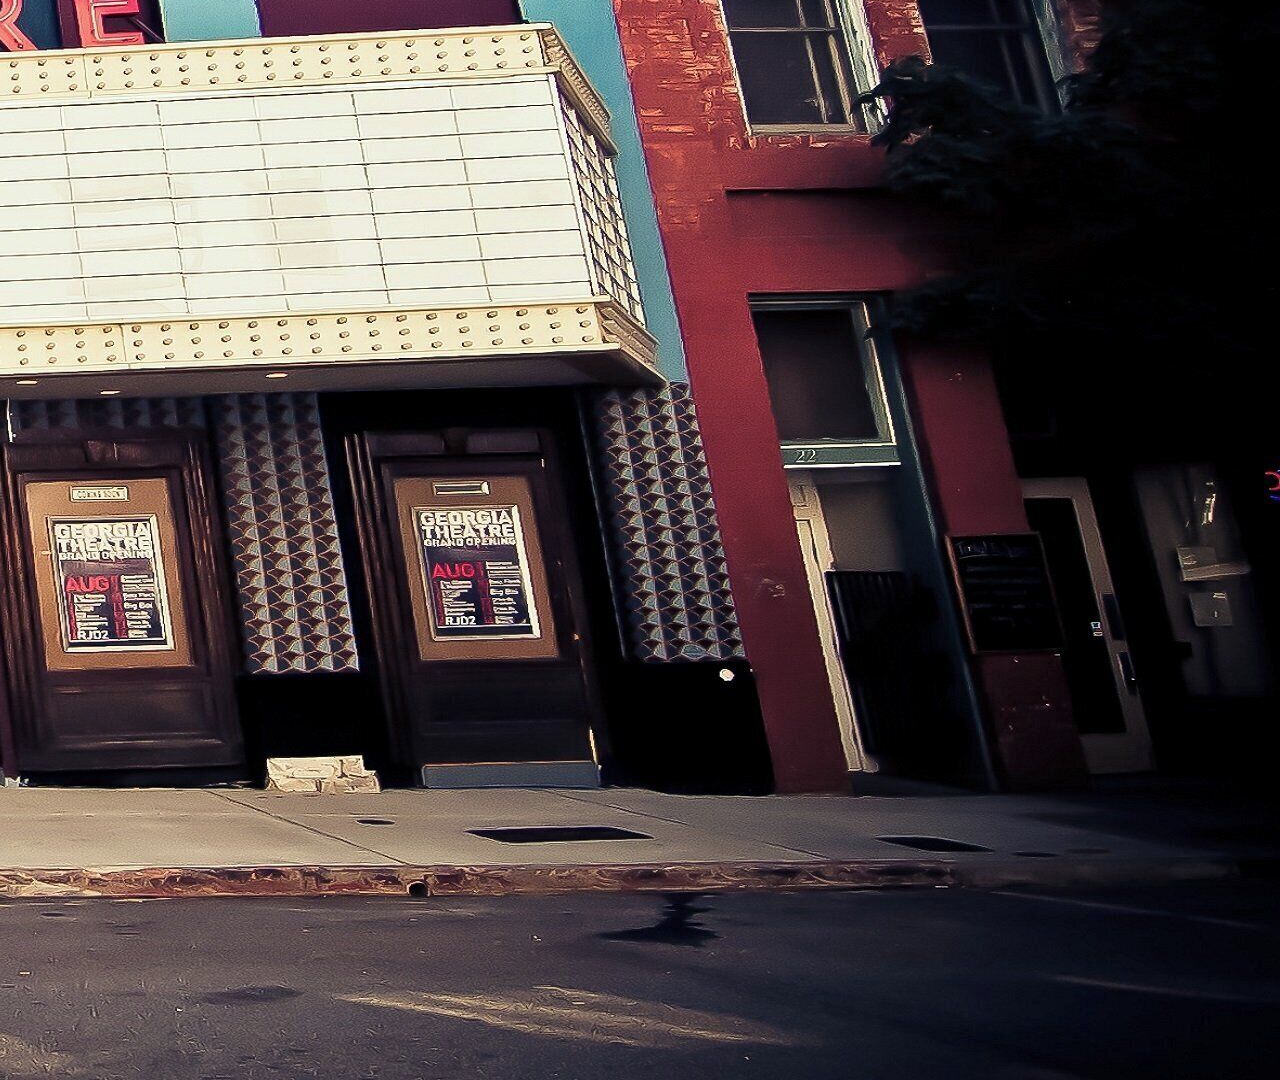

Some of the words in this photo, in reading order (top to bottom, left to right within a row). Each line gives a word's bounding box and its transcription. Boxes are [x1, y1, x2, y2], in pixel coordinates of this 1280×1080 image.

[795, 449, 817, 463] 22
[421, 509, 513, 526] GEORGIA
[54, 523, 150, 539] GEORGIA
[422, 524, 515, 539] THEATRE
[57, 537, 151, 552] THEATRE
[423, 537, 465, 547] GRAND
[466, 536, 516, 546] OPENING
[432, 561, 476, 579] AUG
[64, 574, 111, 592] AUG
[445, 615, 477, 626] RJD2
[77, 630, 109, 641] RJD2
